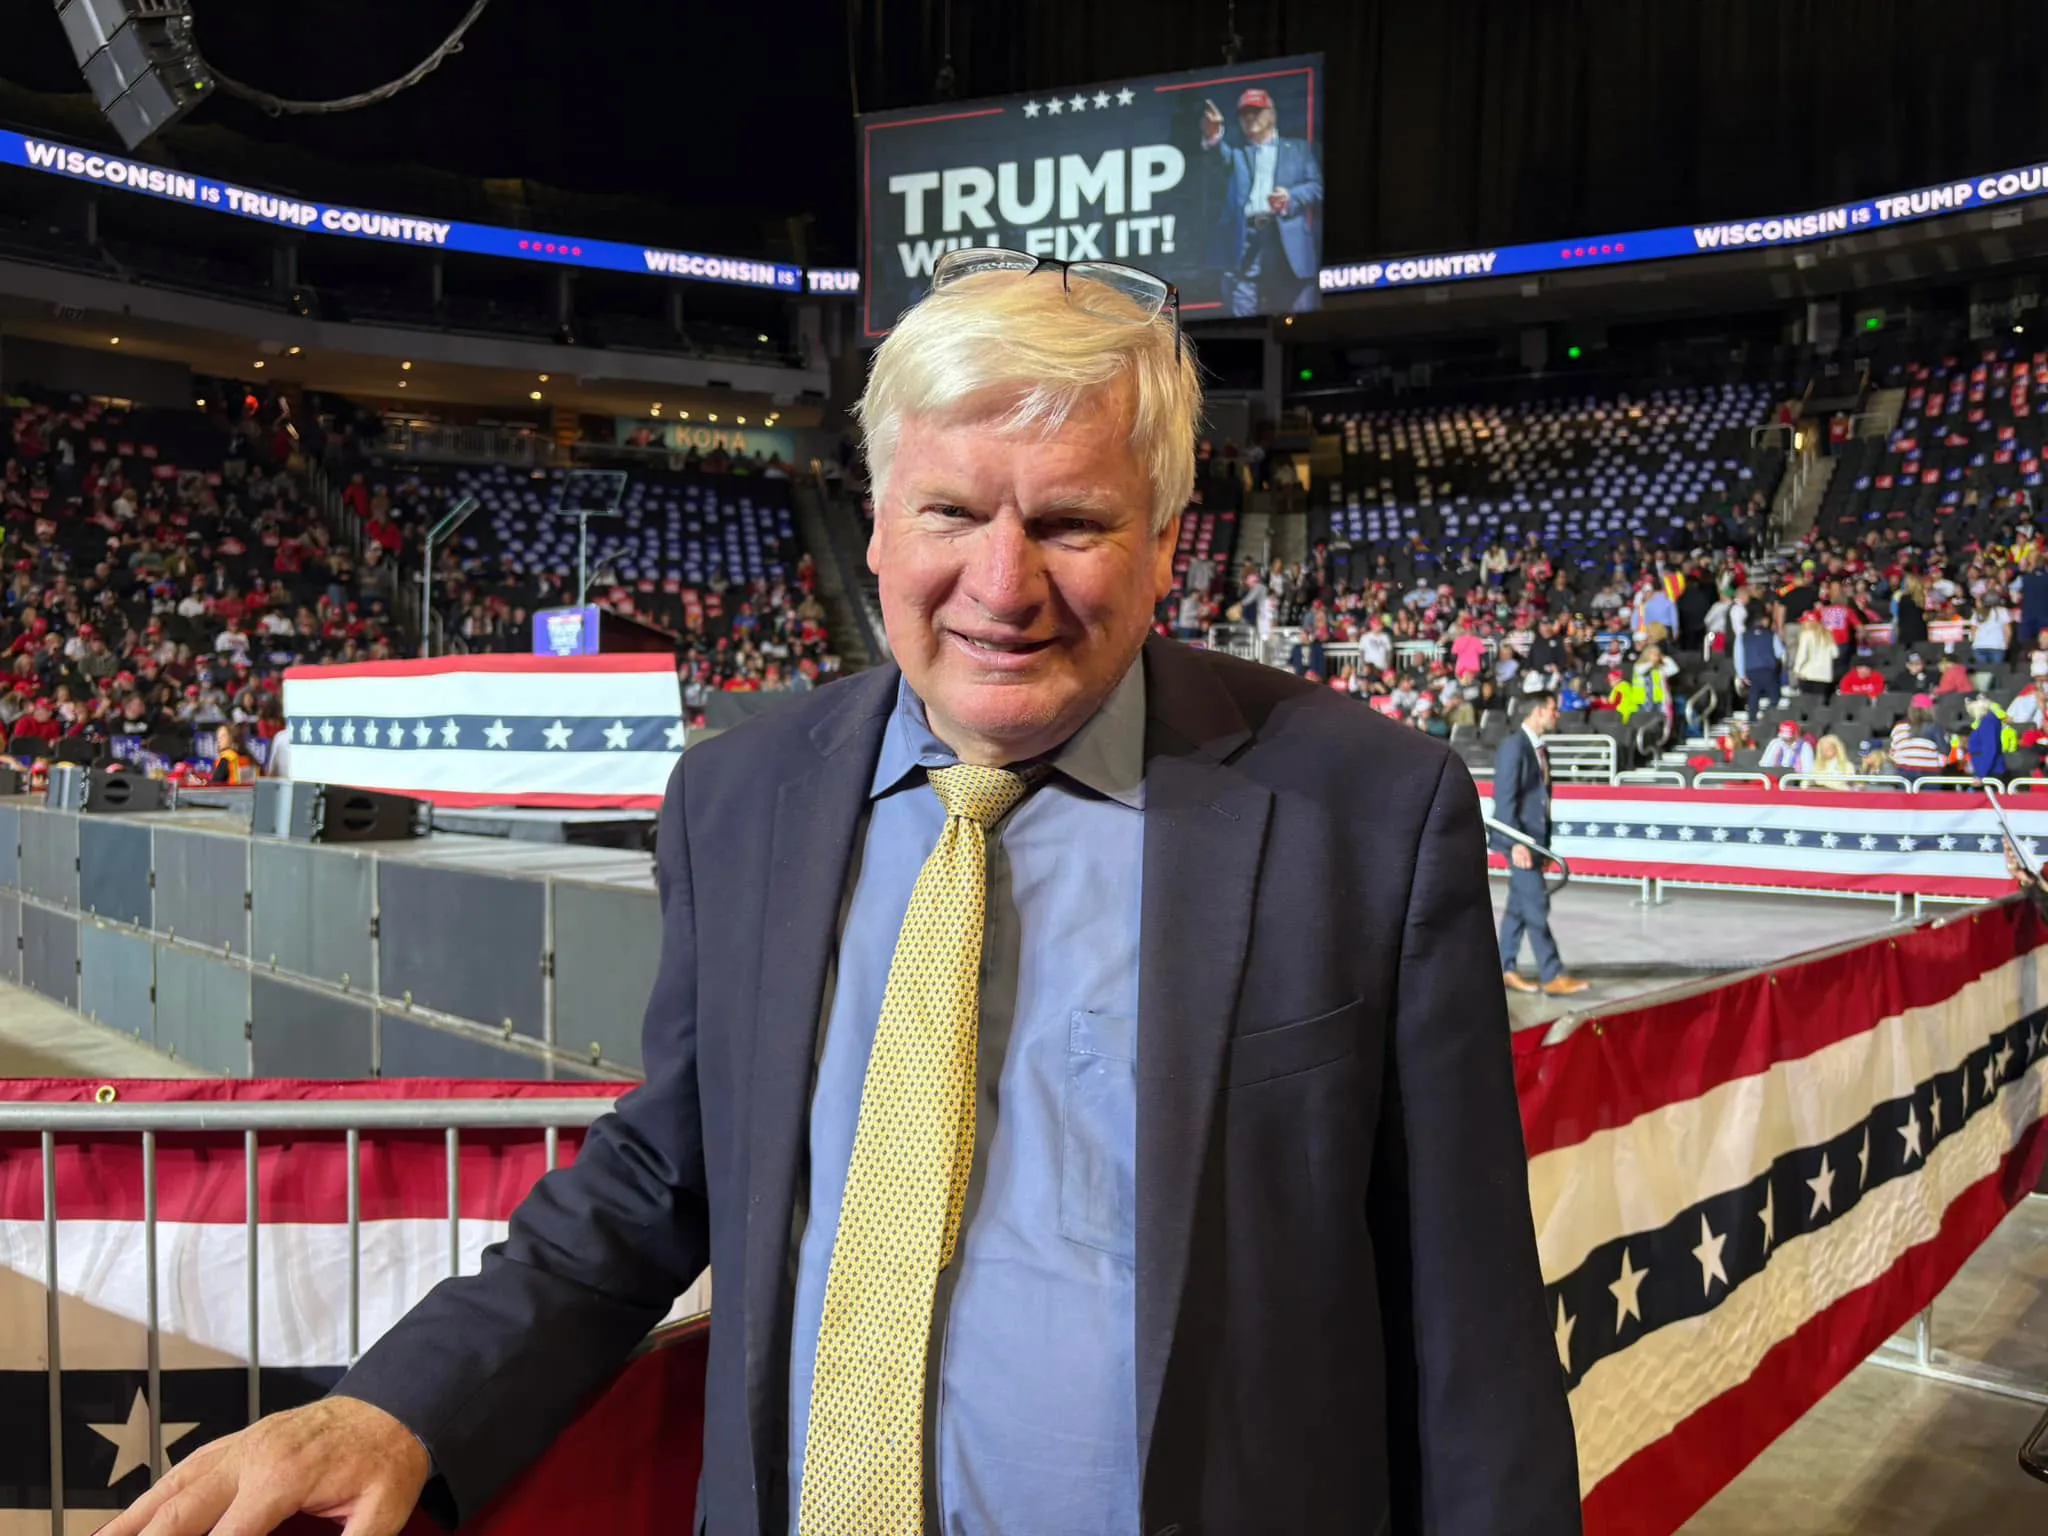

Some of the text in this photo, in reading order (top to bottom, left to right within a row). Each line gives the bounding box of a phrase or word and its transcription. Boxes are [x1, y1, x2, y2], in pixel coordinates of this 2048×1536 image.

[24, 140, 451, 245] WISCONSIN IS TRUMP COUNTRY
[889, 144, 1187, 236] TRUMP
[1693, 208, 1848, 249] WISCONSIN
[1851, 207, 1871, 225] IS
[1874, 183, 1973, 222] TRUMP
[1025, 222, 1104, 262] FIX
[1115, 214, 1176, 258] IT!
[1384, 251, 1498, 282] COUNTRY
[644, 250, 775, 285] WISCONSIN
[777, 270, 796, 286] IS
